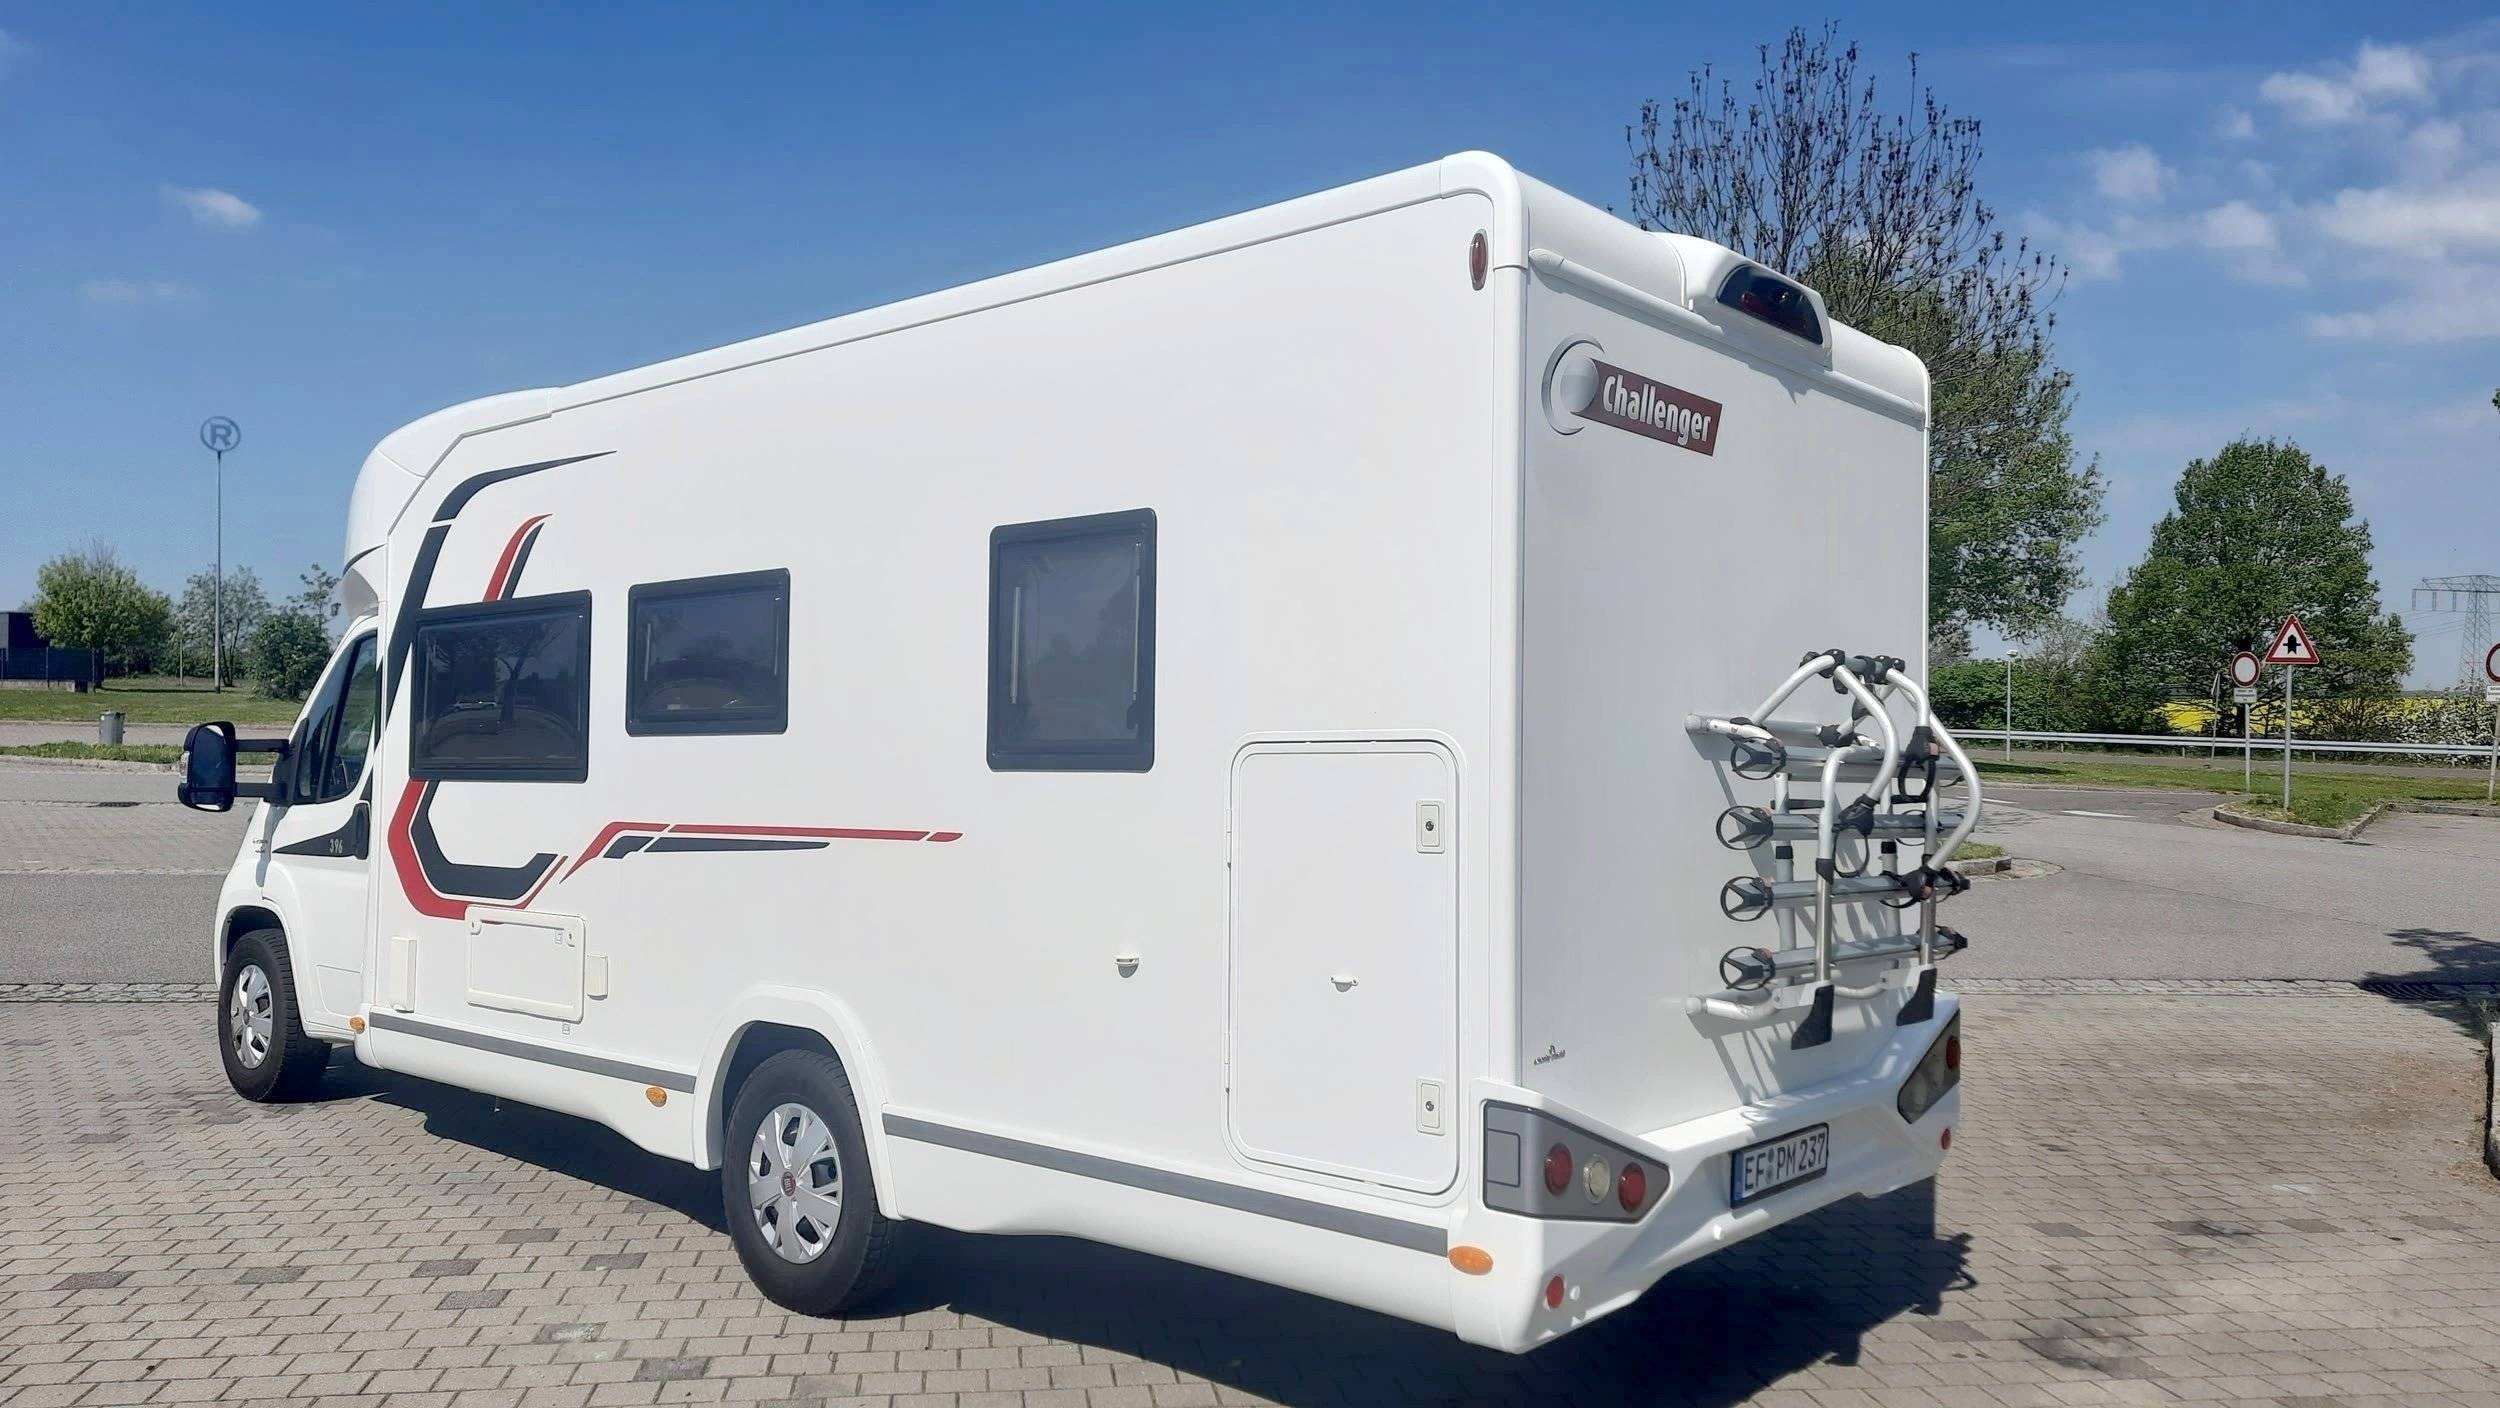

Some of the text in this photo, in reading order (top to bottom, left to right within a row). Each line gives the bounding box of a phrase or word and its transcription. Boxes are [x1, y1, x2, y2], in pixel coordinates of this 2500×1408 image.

[1603, 374, 1712, 445] Challenger
[1744, 1152, 1766, 1191] EF
[1798, 1132, 1826, 1171] 237
